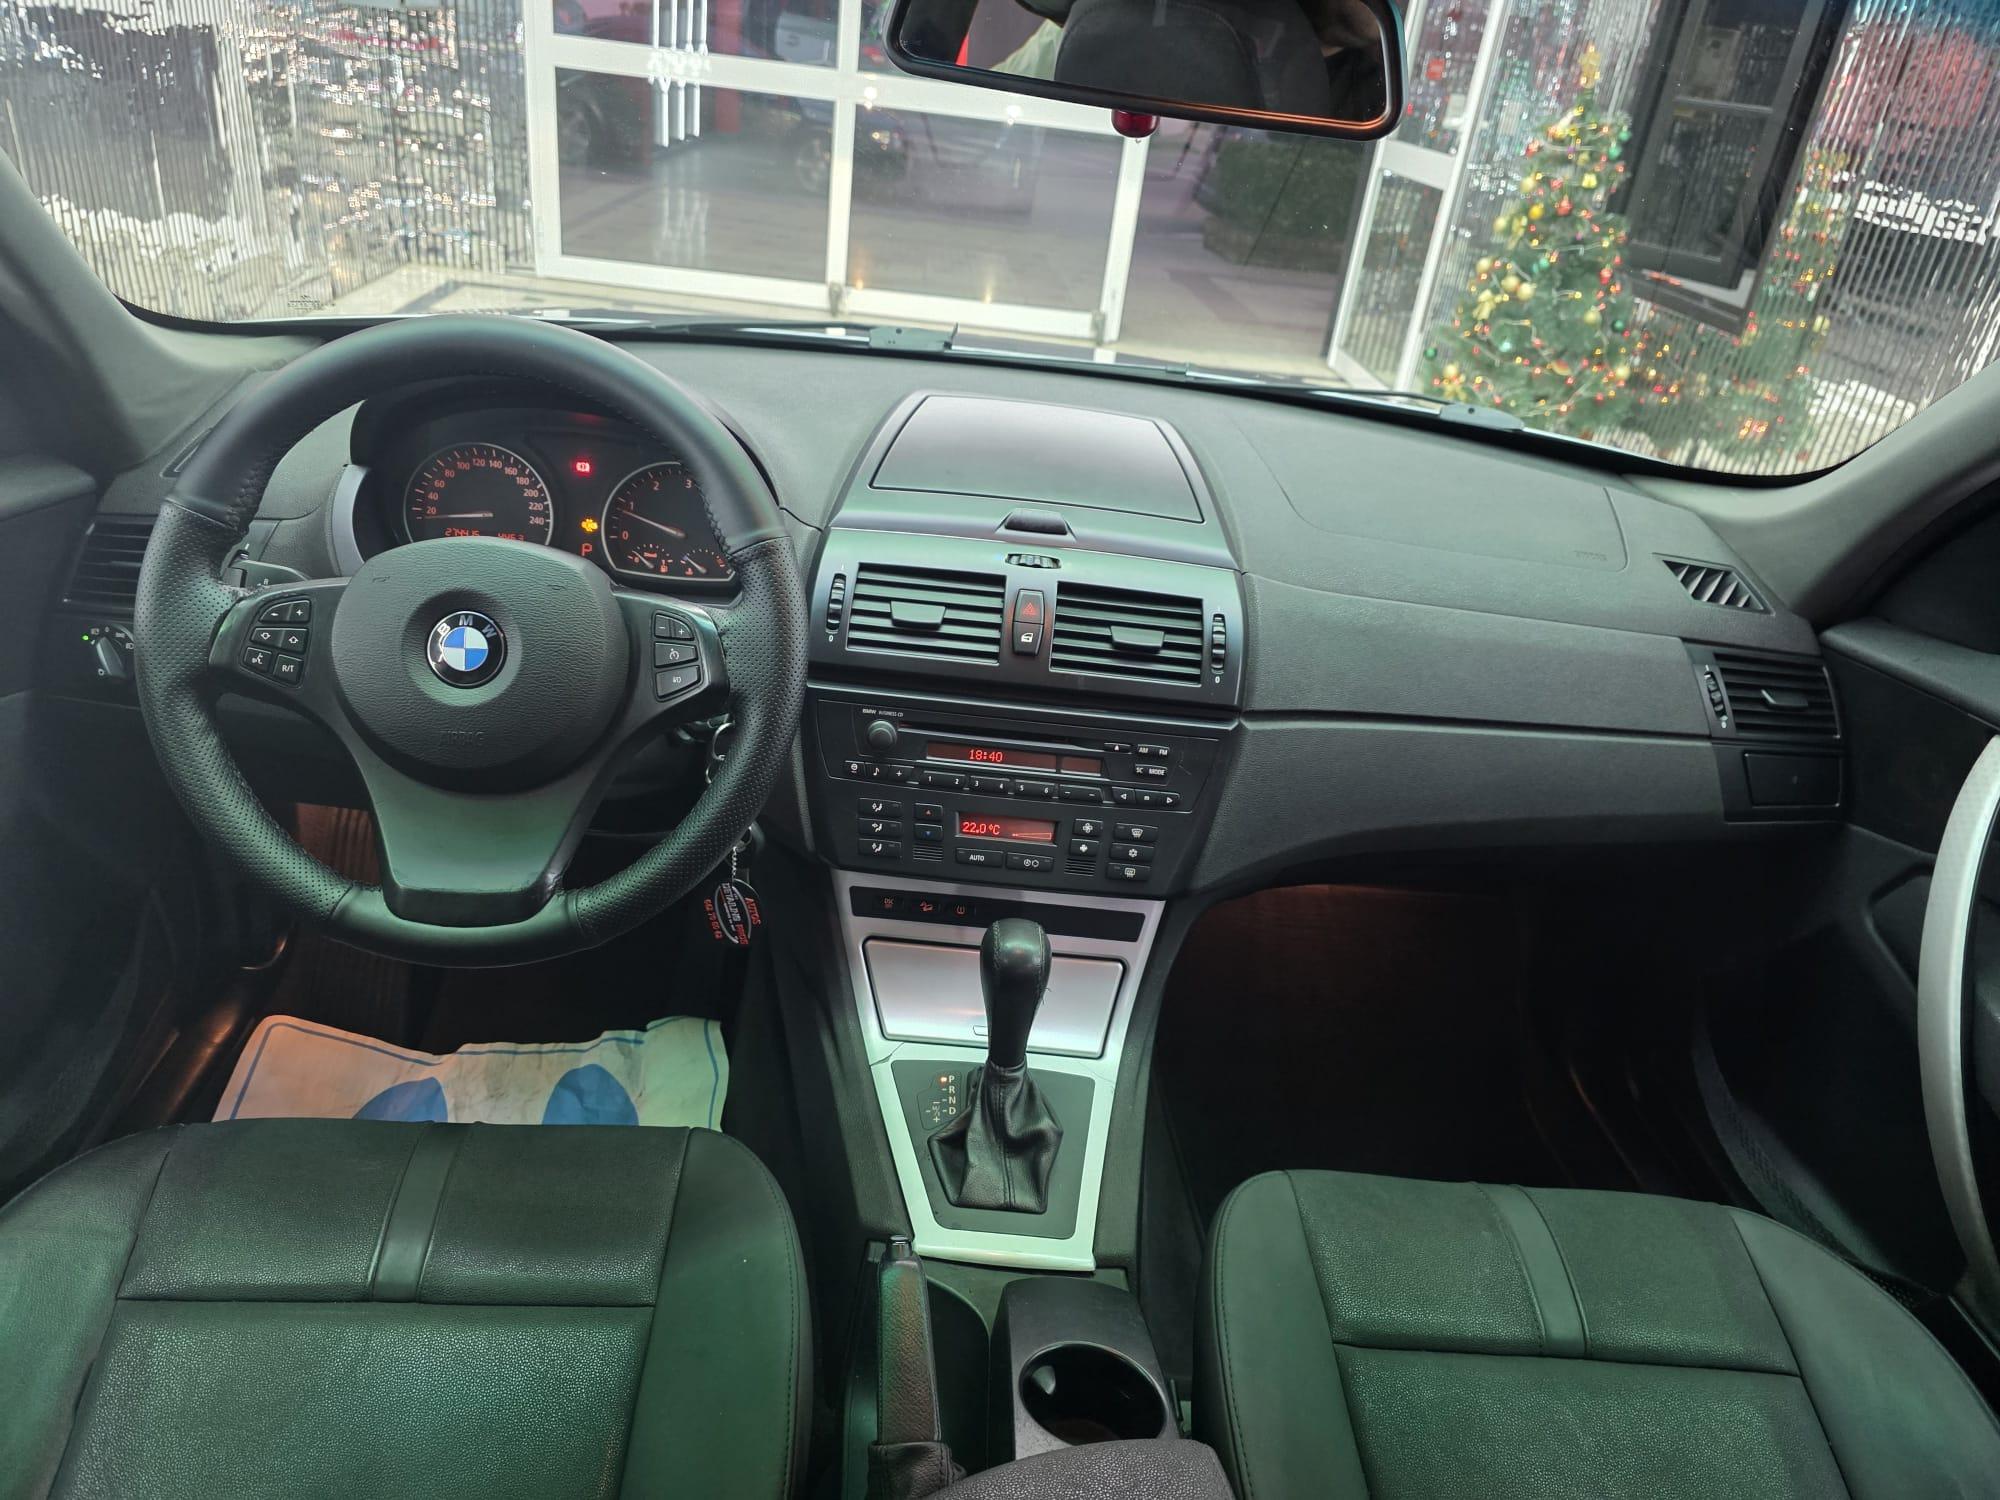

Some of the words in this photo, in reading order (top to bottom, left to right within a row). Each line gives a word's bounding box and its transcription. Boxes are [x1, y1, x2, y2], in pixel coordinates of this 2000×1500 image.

[457, 461, 470, 470] 100
[472, 458, 486, 467] 120
[489, 460, 502, 468] 140
[444, 469, 455, 478] 80
[504, 467, 518, 476] 160
[434, 480, 445, 488] 60
[516, 476, 529, 485] 180
[685, 479, 692, 489] 3
[653, 481, 660, 491] 2
[428, 493, 439, 501] 40
[523, 489, 539, 497] 200
[426, 506, 437, 515] 20
[528, 502, 544, 511] 220
[529, 516, 545, 525] 240
[622, 530, 629, 540] 0
[582, 543, 592, 556] P
[437, 615, 497, 638] BMW
[282, 664, 294, 672] R/T
[968, 749, 1003, 762] 18:40
[1149, 768, 1165, 776] MODE
[962, 821, 986, 834] 22.0
[988, 824, 1001, 835] °C
[969, 854, 985, 862] AUTO
[949, 1075, 955, 1083] P
[949, 1086, 956, 1094] R
[949, 1096, 956, 1104] N
[949, 1107, 956, 1115] D
